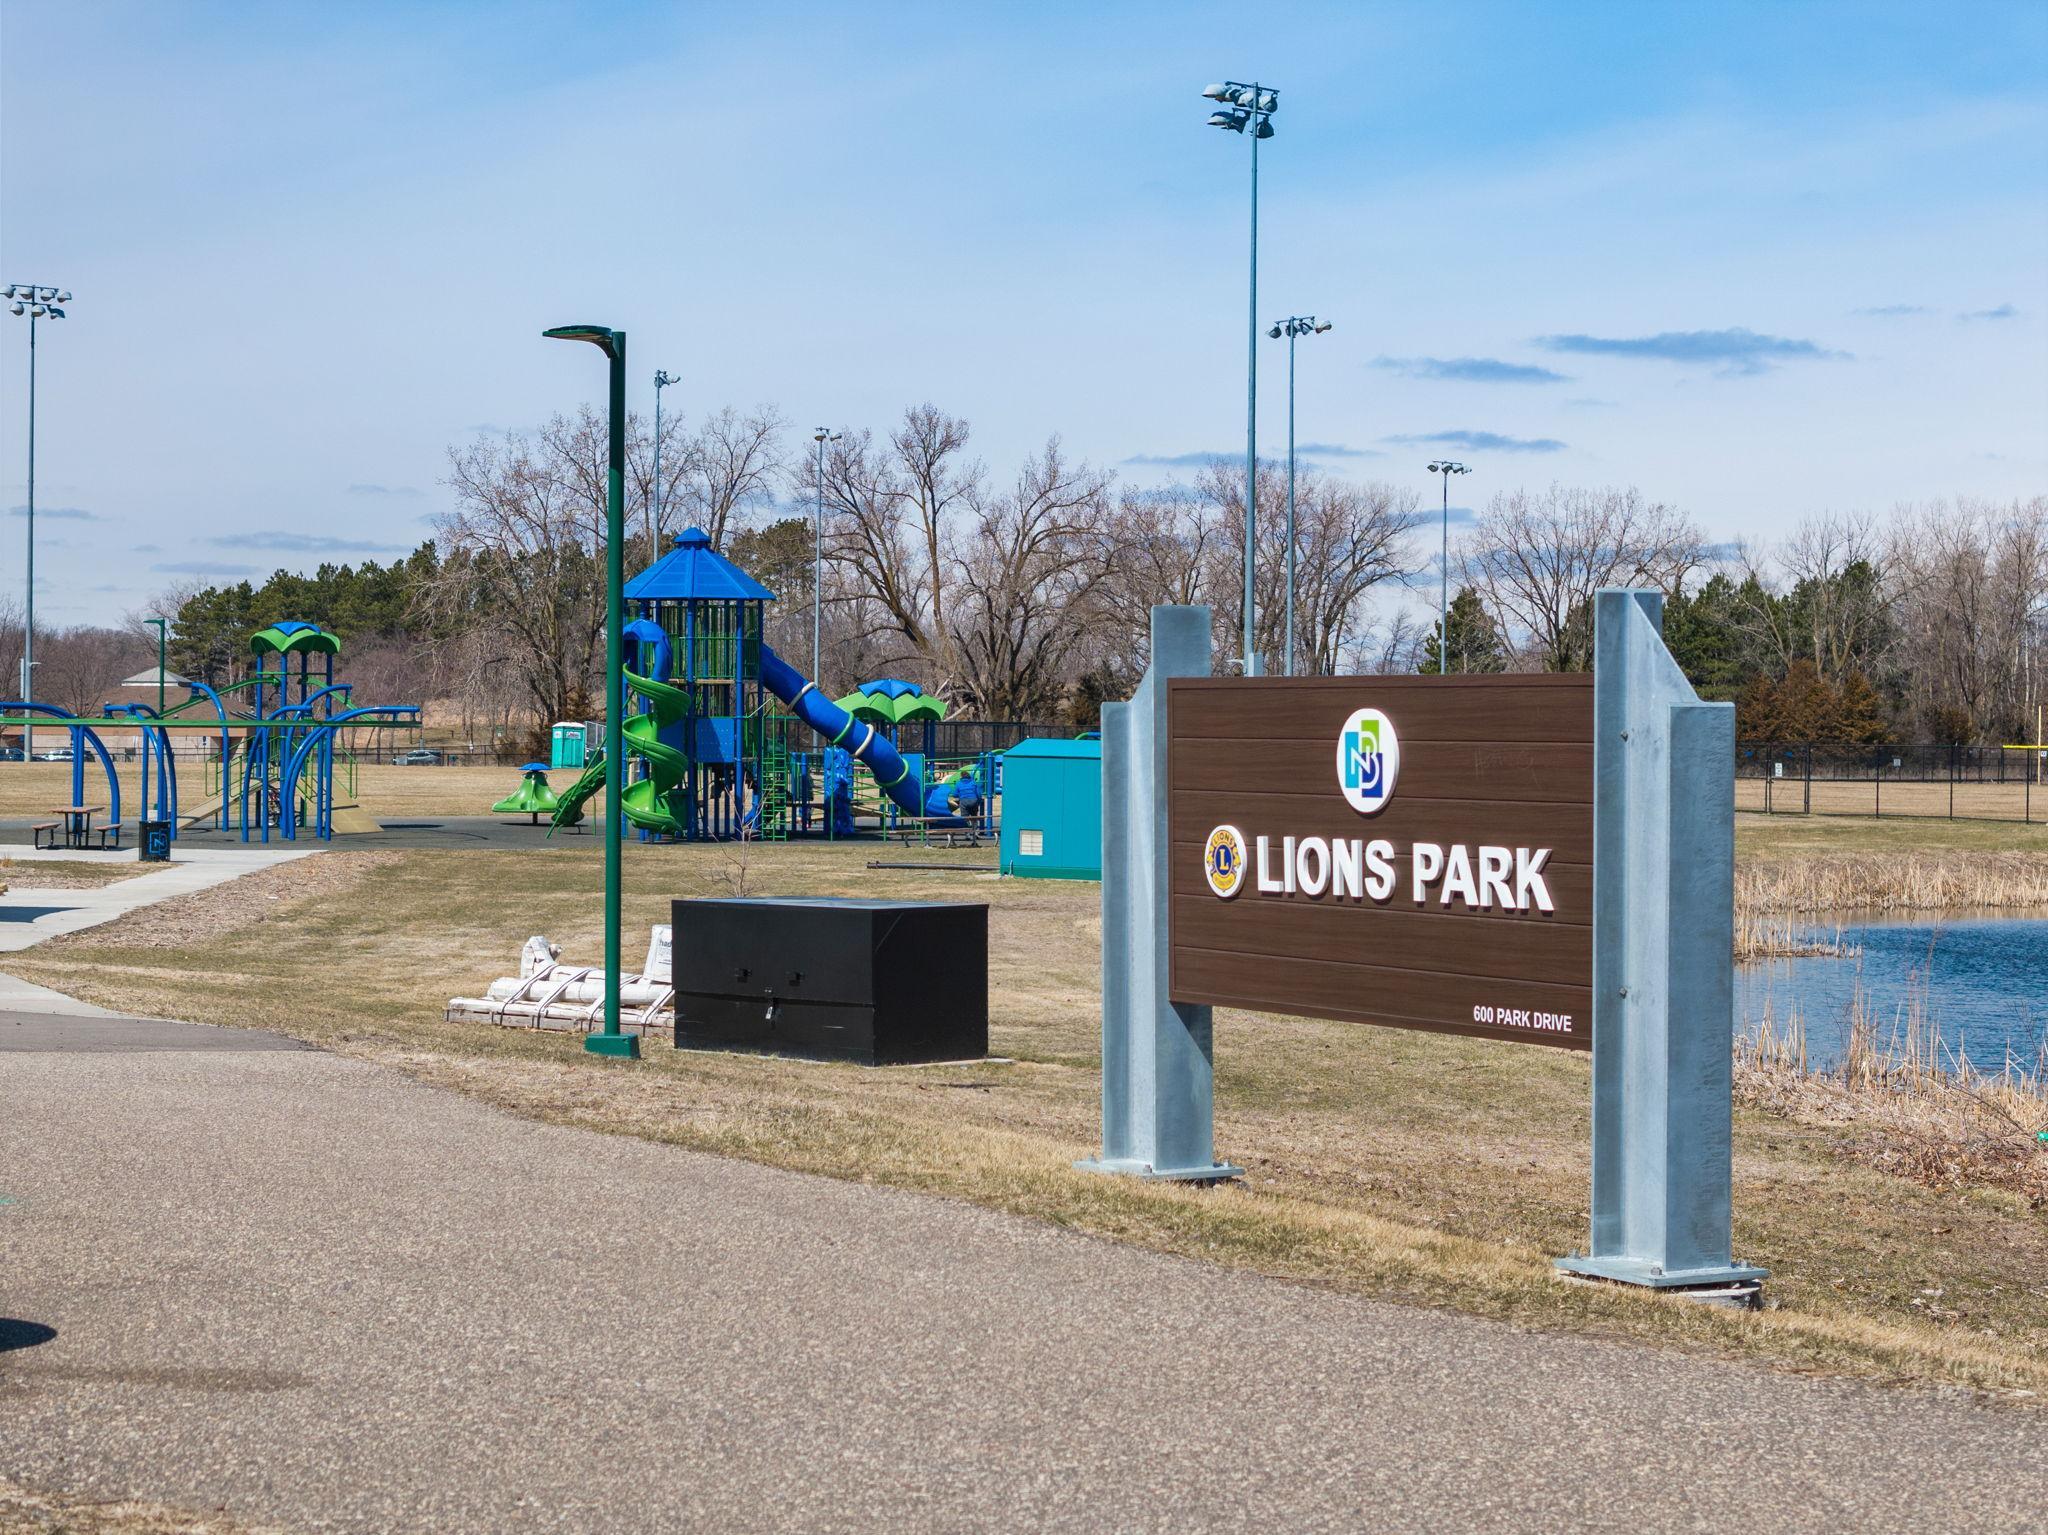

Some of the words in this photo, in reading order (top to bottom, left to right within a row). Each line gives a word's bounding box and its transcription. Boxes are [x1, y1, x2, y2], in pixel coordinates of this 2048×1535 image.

[1213, 832, 1234, 845] LIONS
[1219, 849, 1229, 870] L
[1257, 836, 1396, 900] LIONS
[1413, 843, 1554, 911] PARK
[1473, 1005, 1494, 1023] 600
[1496, 1008, 1531, 1027] PARK
[1533, 1012, 1572, 1032] DRIVE
